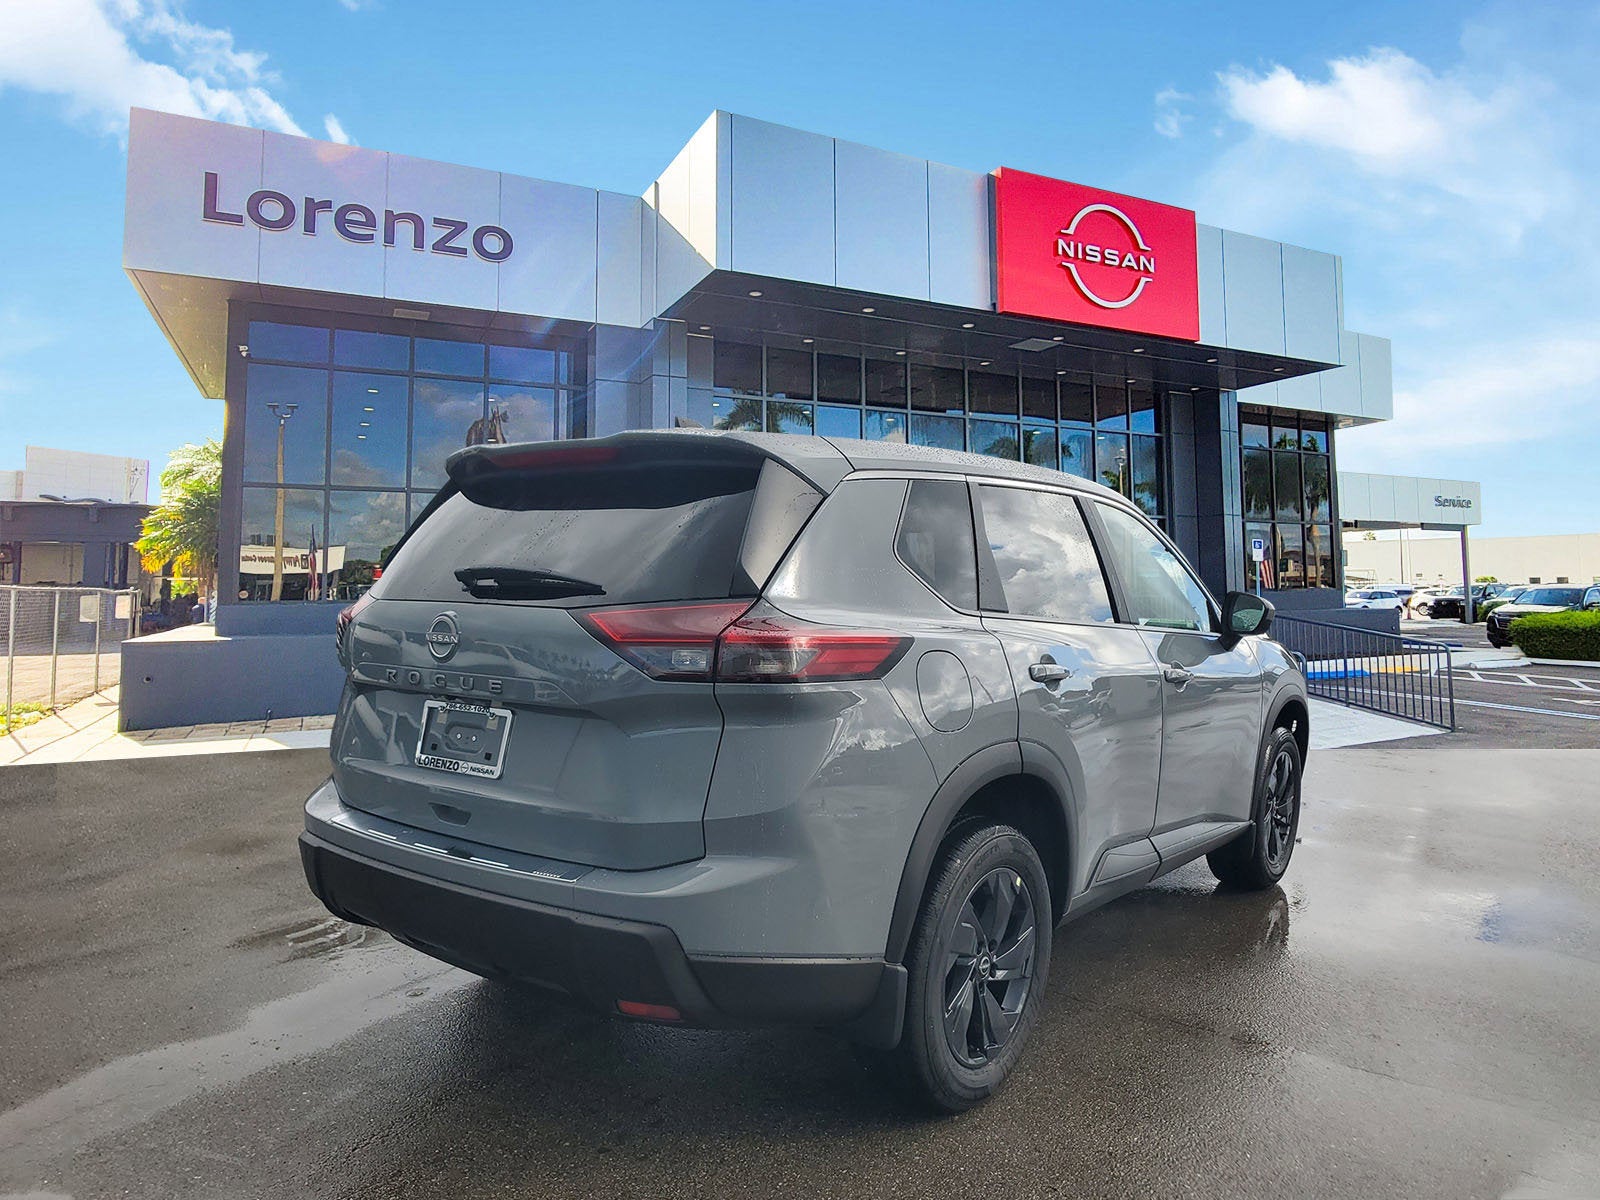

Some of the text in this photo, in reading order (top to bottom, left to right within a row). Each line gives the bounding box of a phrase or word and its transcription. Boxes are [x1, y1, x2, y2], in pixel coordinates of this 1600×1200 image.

[202, 171, 514, 262] Lorenzo
[1057, 238, 1155, 273] NISSAN
[1434, 495, 1472, 509] Service
[426, 632, 459, 644] NISSAN
[386, 669, 503, 693] ROGUE
[418, 755, 495, 776] LORENZO NISSAN
